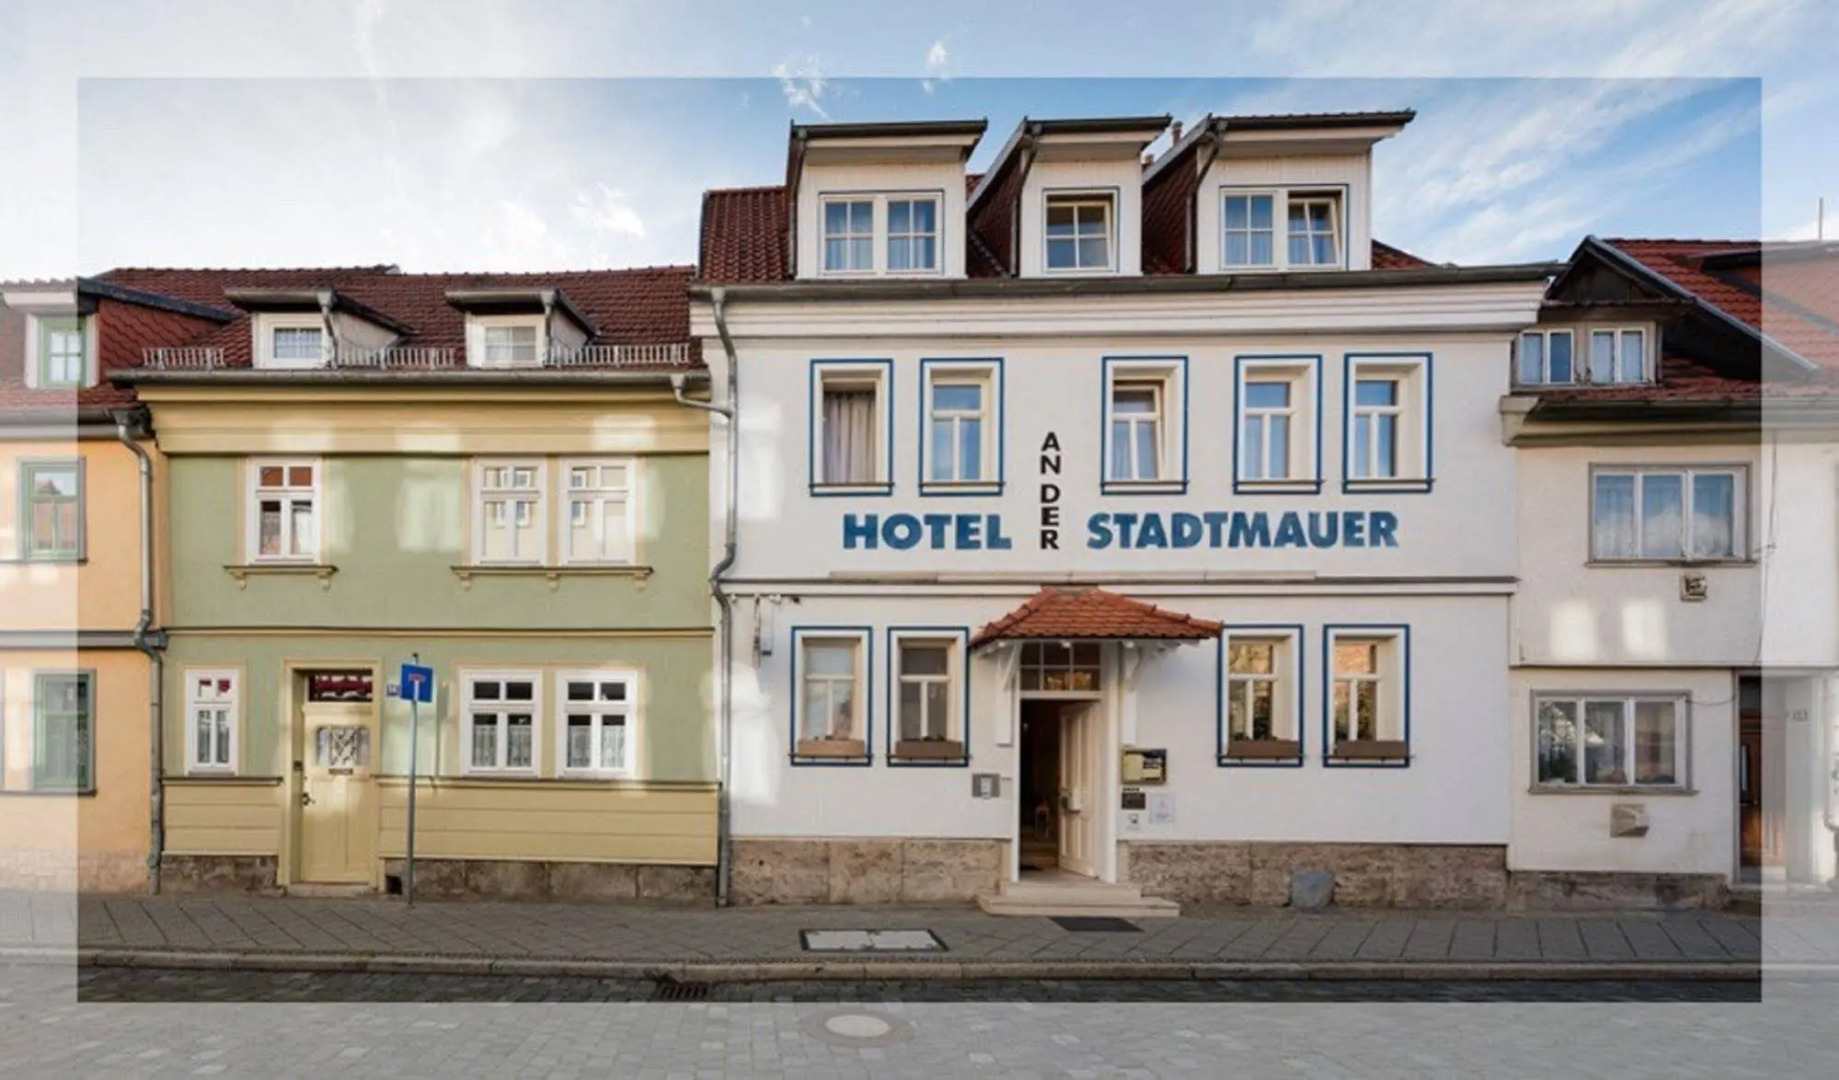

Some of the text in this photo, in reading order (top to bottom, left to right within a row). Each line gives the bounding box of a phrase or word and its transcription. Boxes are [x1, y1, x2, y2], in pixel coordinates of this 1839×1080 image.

[1041, 432, 1061, 549] AN DER
[843, 513, 1012, 550] HOTEL
[1087, 511, 1398, 549] STADTMAUER
